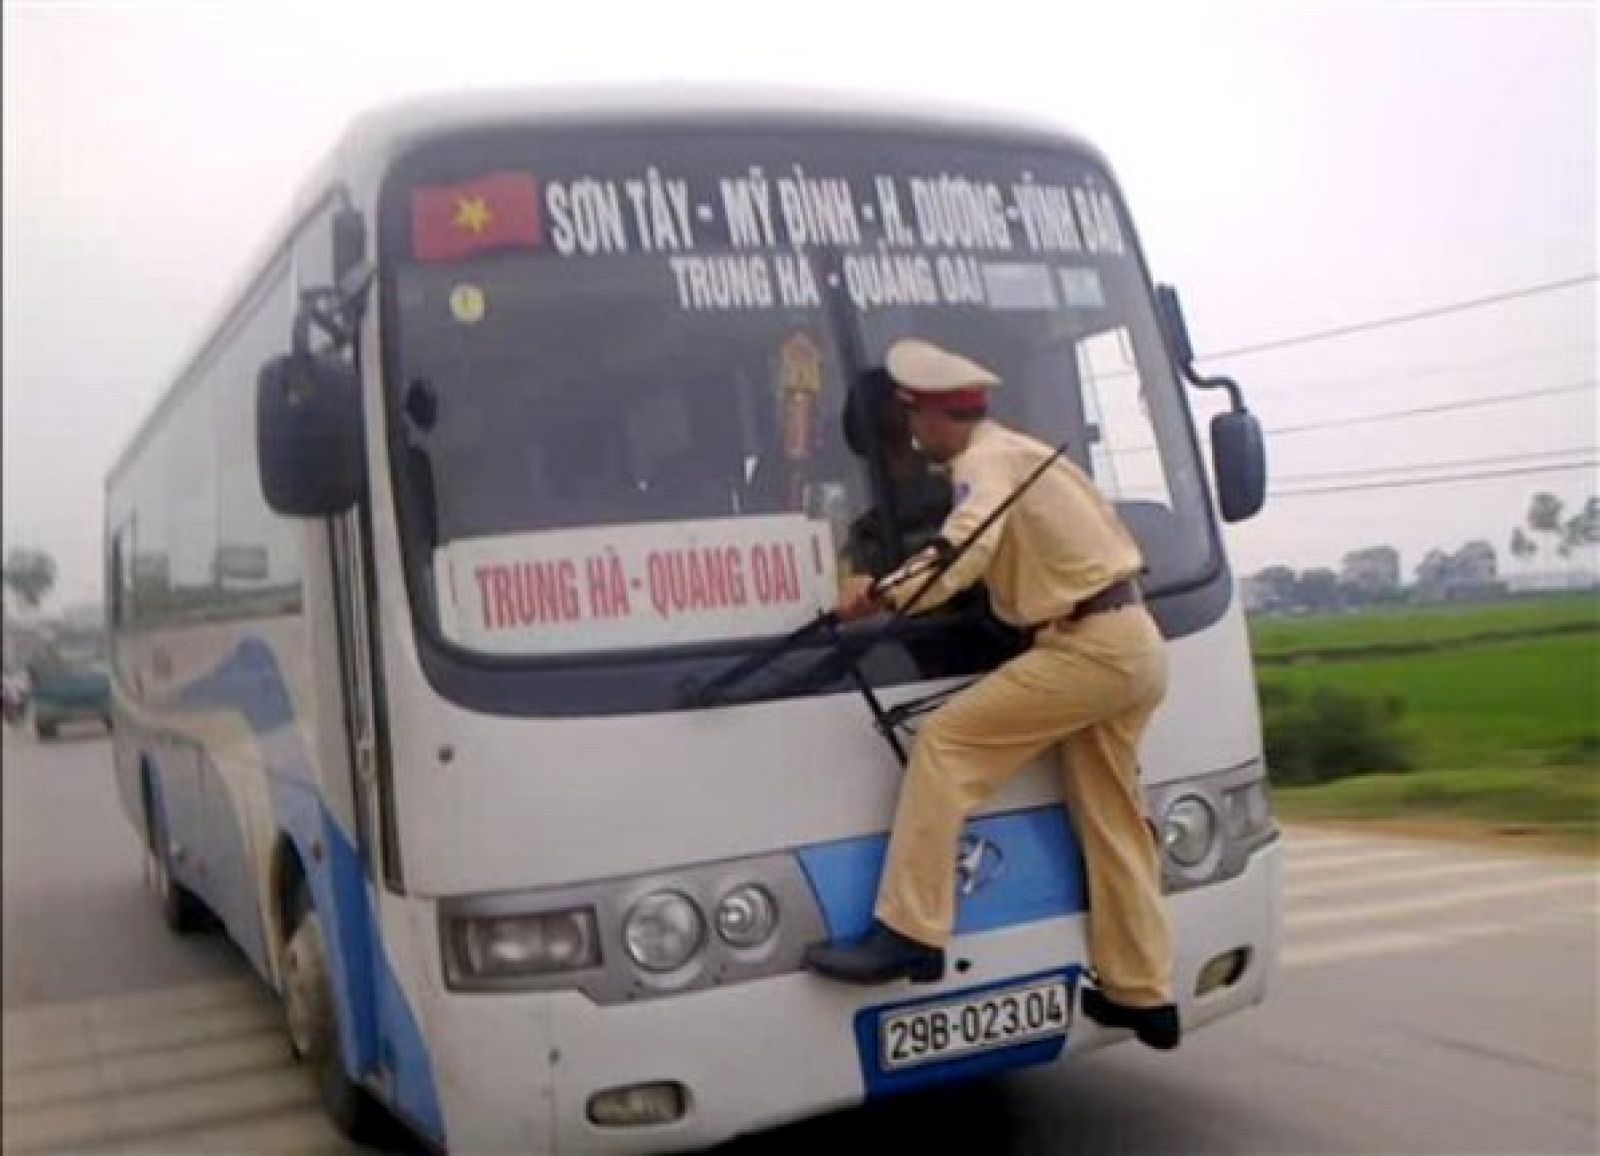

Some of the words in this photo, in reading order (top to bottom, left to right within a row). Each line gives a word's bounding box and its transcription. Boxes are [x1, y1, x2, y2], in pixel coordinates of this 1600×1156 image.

[545, 174, 627, 256] SƠN
[625, 166, 694, 250] TÂY
[719, 165, 775, 247] MỸ
[778, 163, 861, 246] ĐÌNH
[874, 174, 913, 246] H.
[669, 256, 773, 310] TRUNG
[935, 256, 985, 304] OAI
[475, 560, 580, 632] TRUNG
[586, 545, 630, 619] HÀ
[751, 542, 801, 604] OAI
[889, 989, 1063, 1060] 29B-023.04
